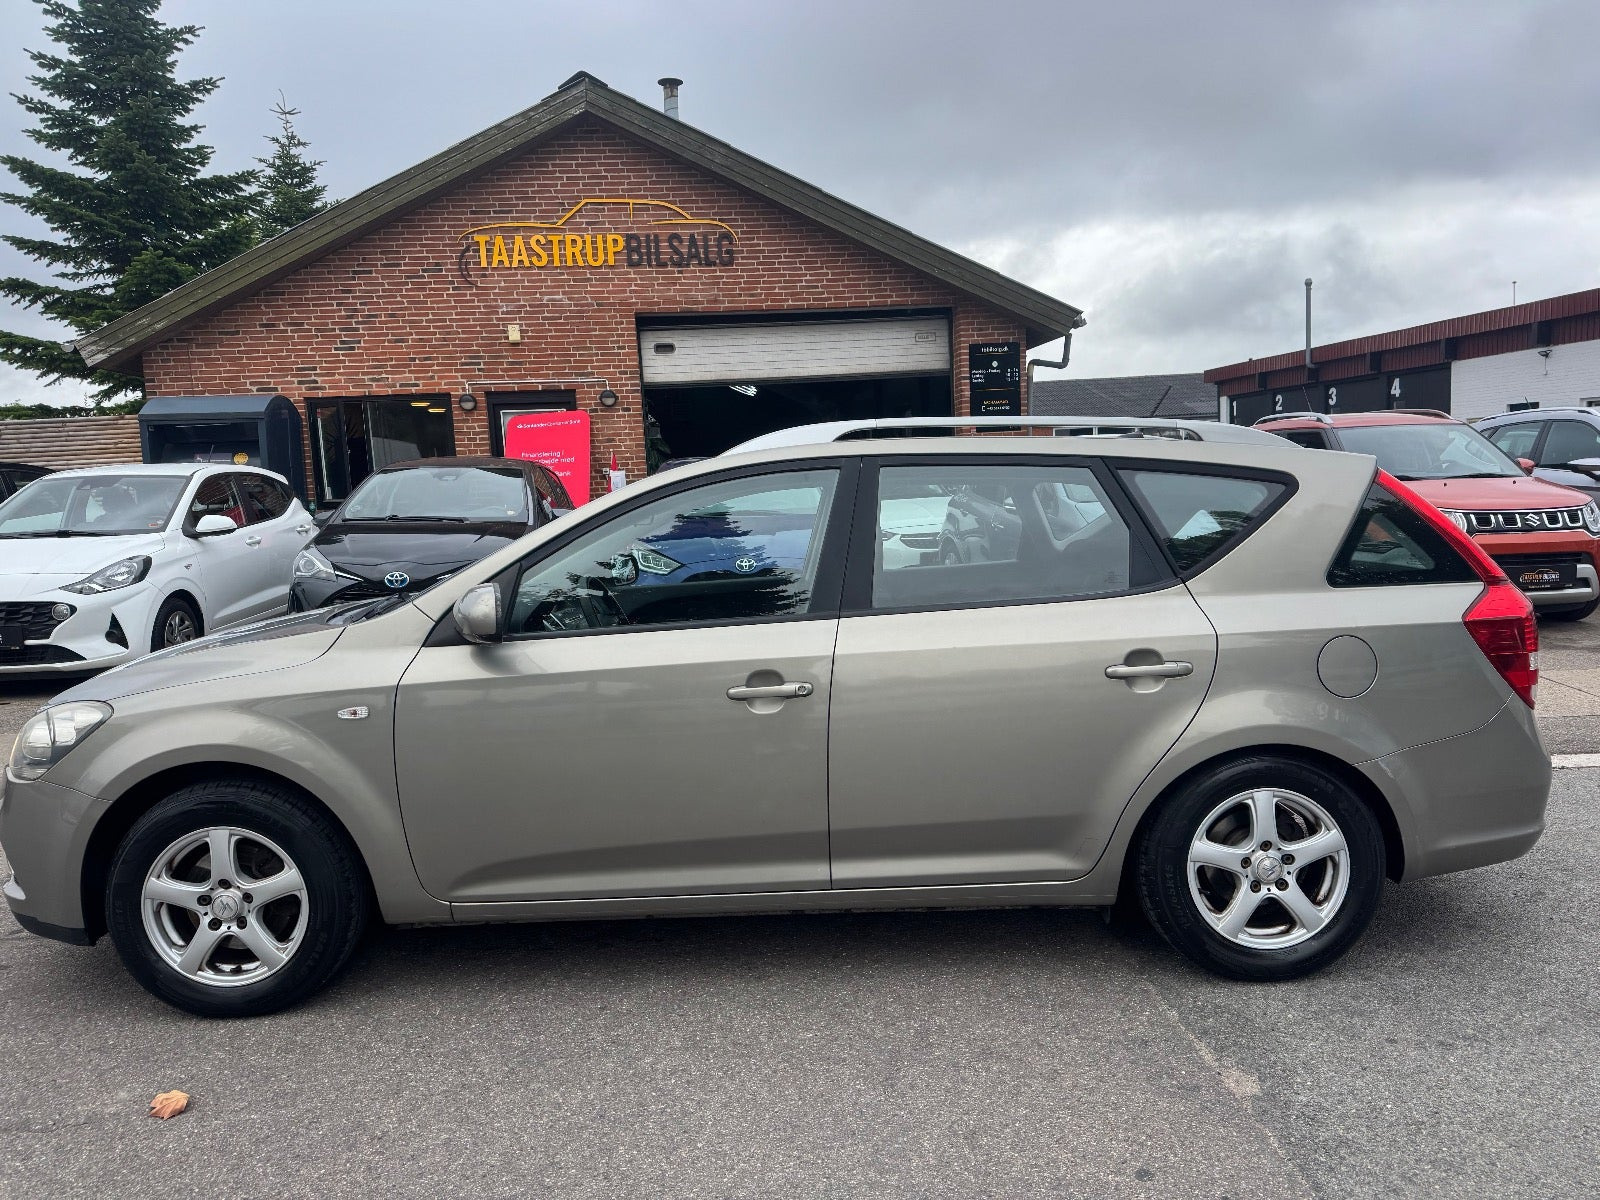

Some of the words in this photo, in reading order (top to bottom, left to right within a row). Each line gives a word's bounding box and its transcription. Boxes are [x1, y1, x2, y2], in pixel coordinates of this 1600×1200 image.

[1328, 387, 1337, 406] 3
[1390, 377, 1401, 398] 4
[1232, 400, 1237, 416] 1
[1275, 394, 1283, 411] 2
